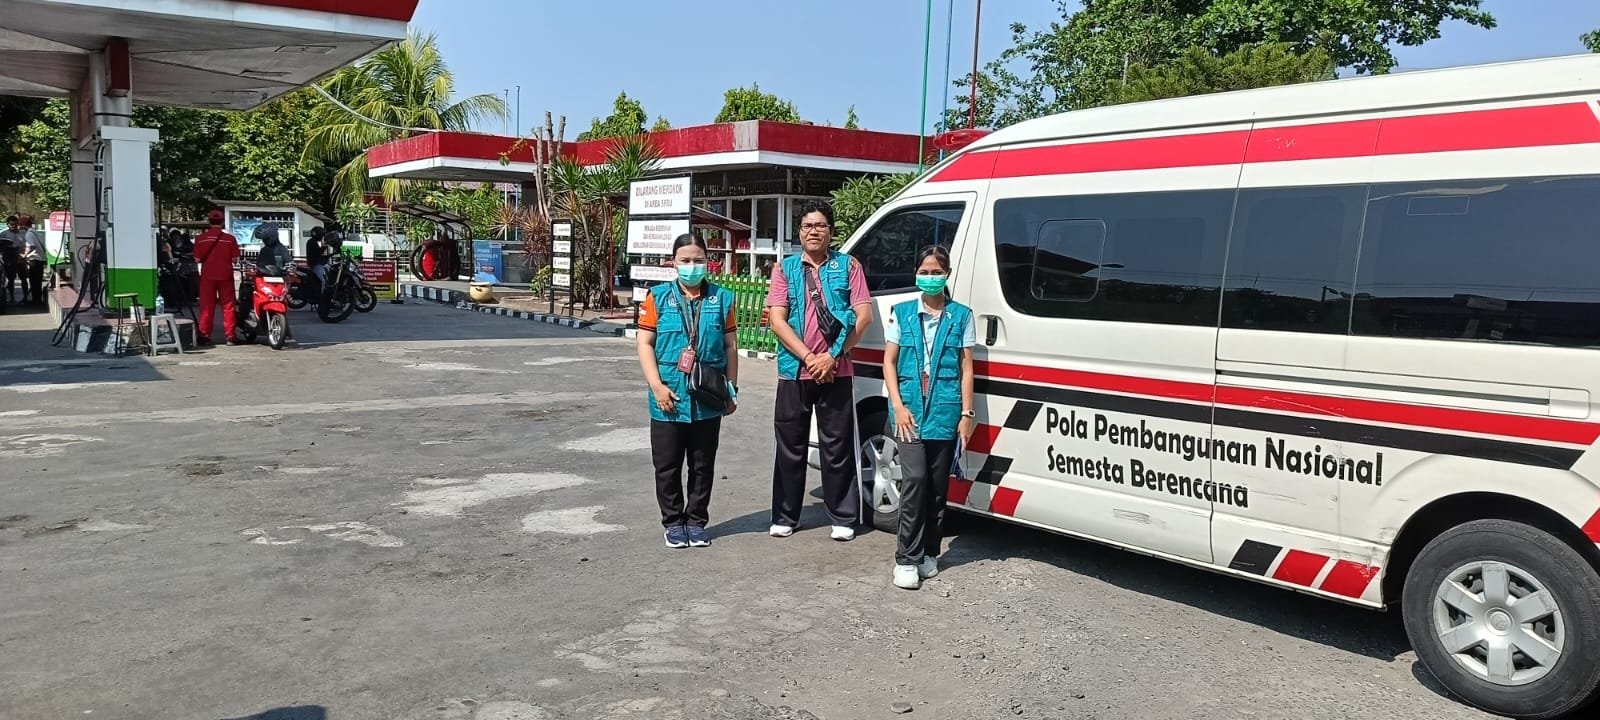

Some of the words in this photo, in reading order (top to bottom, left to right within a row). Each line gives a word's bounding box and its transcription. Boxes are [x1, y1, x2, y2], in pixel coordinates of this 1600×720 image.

[1046, 406, 1088, 440] Pola
[1094, 411, 1257, 466] Pembangunan
[1264, 437, 1383, 487] Nasional
[1047, 445, 1125, 484] Semesta
[1130, 458, 1249, 508] Berencana
